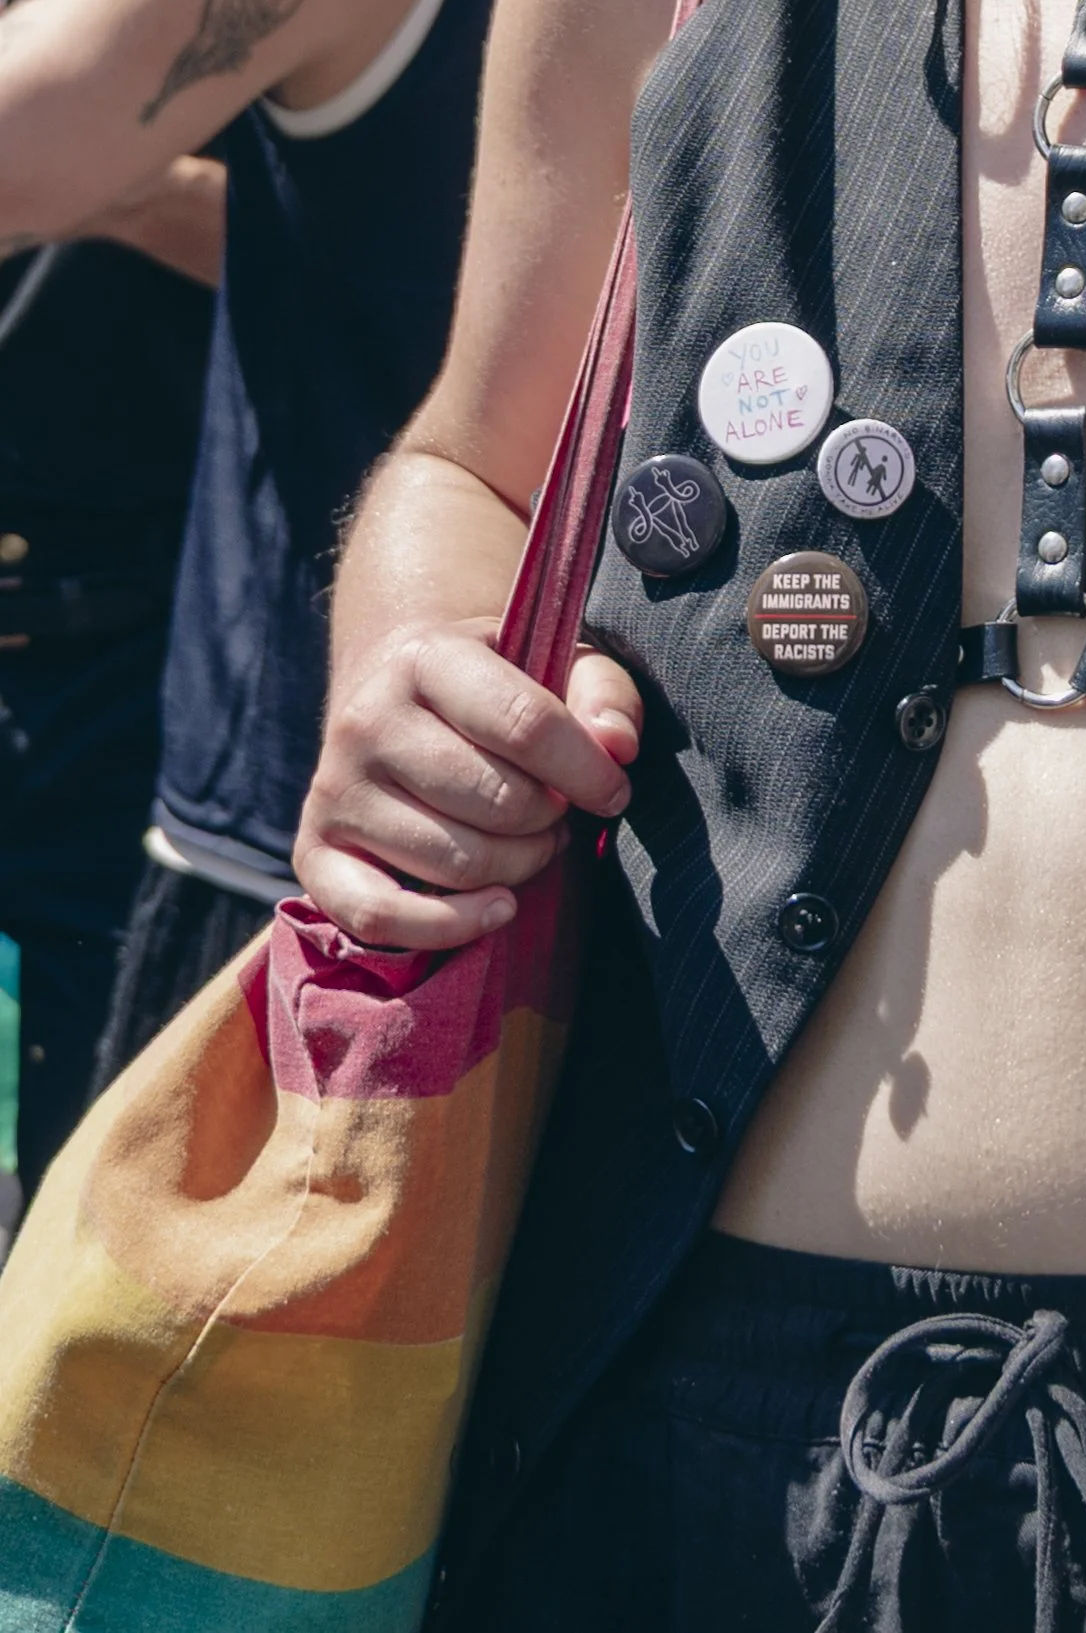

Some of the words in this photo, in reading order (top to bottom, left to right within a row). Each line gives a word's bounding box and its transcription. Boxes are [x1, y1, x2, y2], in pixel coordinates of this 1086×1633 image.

[728, 337, 779, 369] YOU
[737, 366, 789, 394] ARE
[738, 388, 791, 415] NOT
[725, 409, 805, 444] ALONE
[843, 427, 859, 439] NO
[772, 573, 810, 589] KEEP
[813, 573, 841, 589] THE
[762, 593, 850, 609] IMMIGRANTS
[762, 623, 817, 640] DEPORT
[820, 623, 849, 640] THE
[773, 644, 835, 660] RACISTS
